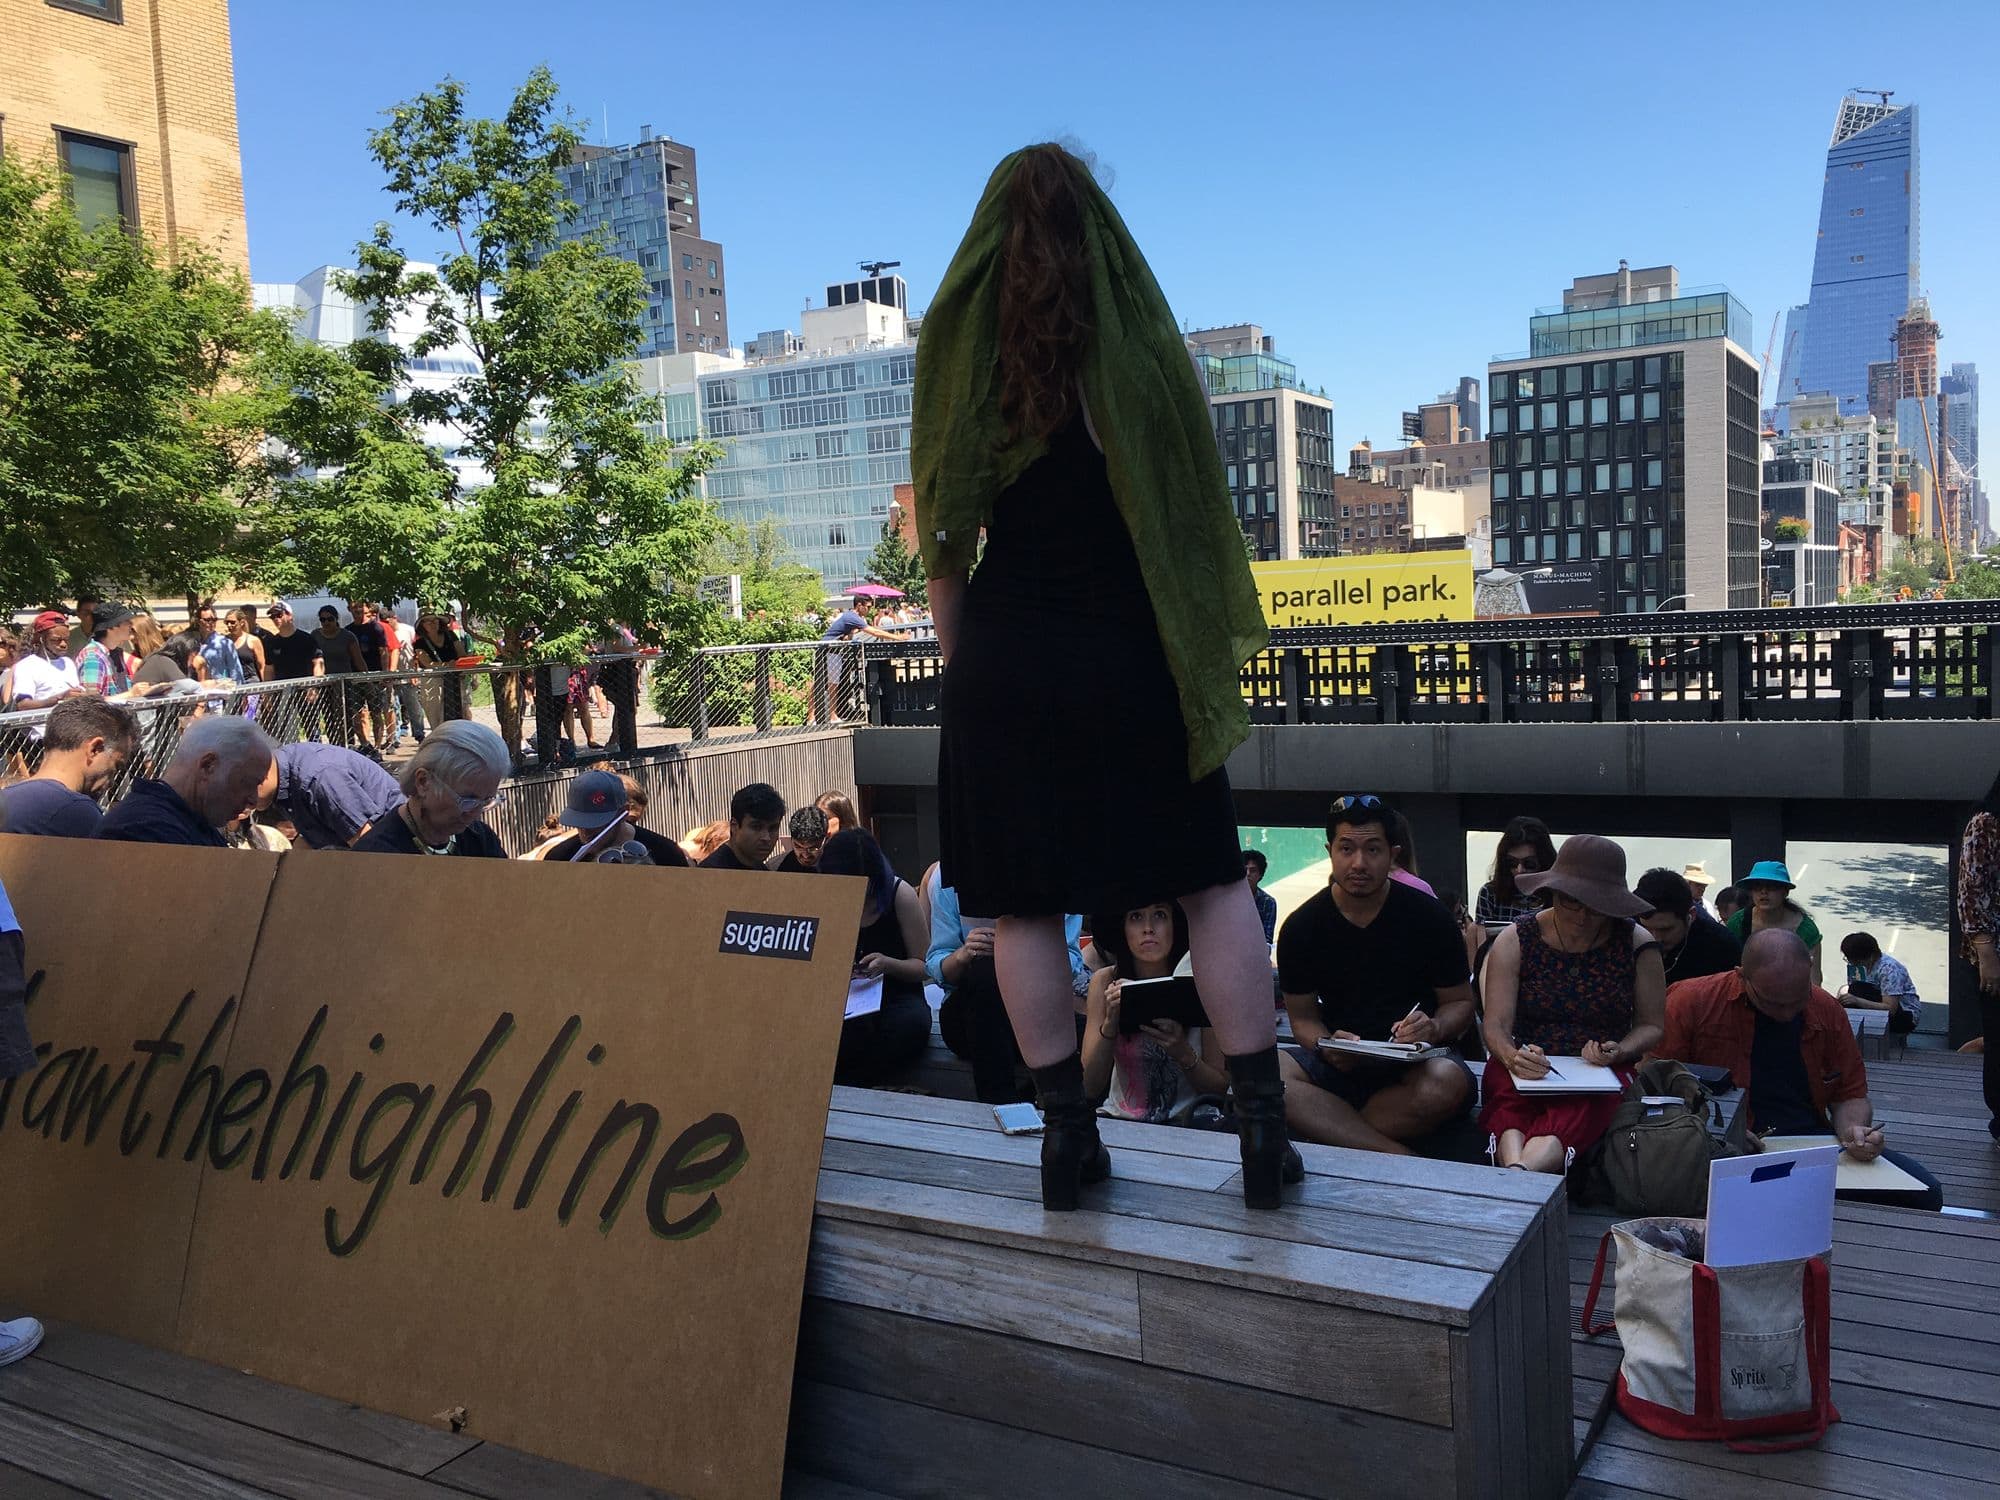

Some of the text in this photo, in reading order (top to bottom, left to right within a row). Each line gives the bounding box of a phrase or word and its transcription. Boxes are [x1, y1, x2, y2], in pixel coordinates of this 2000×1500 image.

[1272, 578, 1371, 615] parallel
[1383, 574, 1456, 610] park.
[724, 919, 813, 953] sugarlift
[0, 969, 750, 1257] rawthehighline
